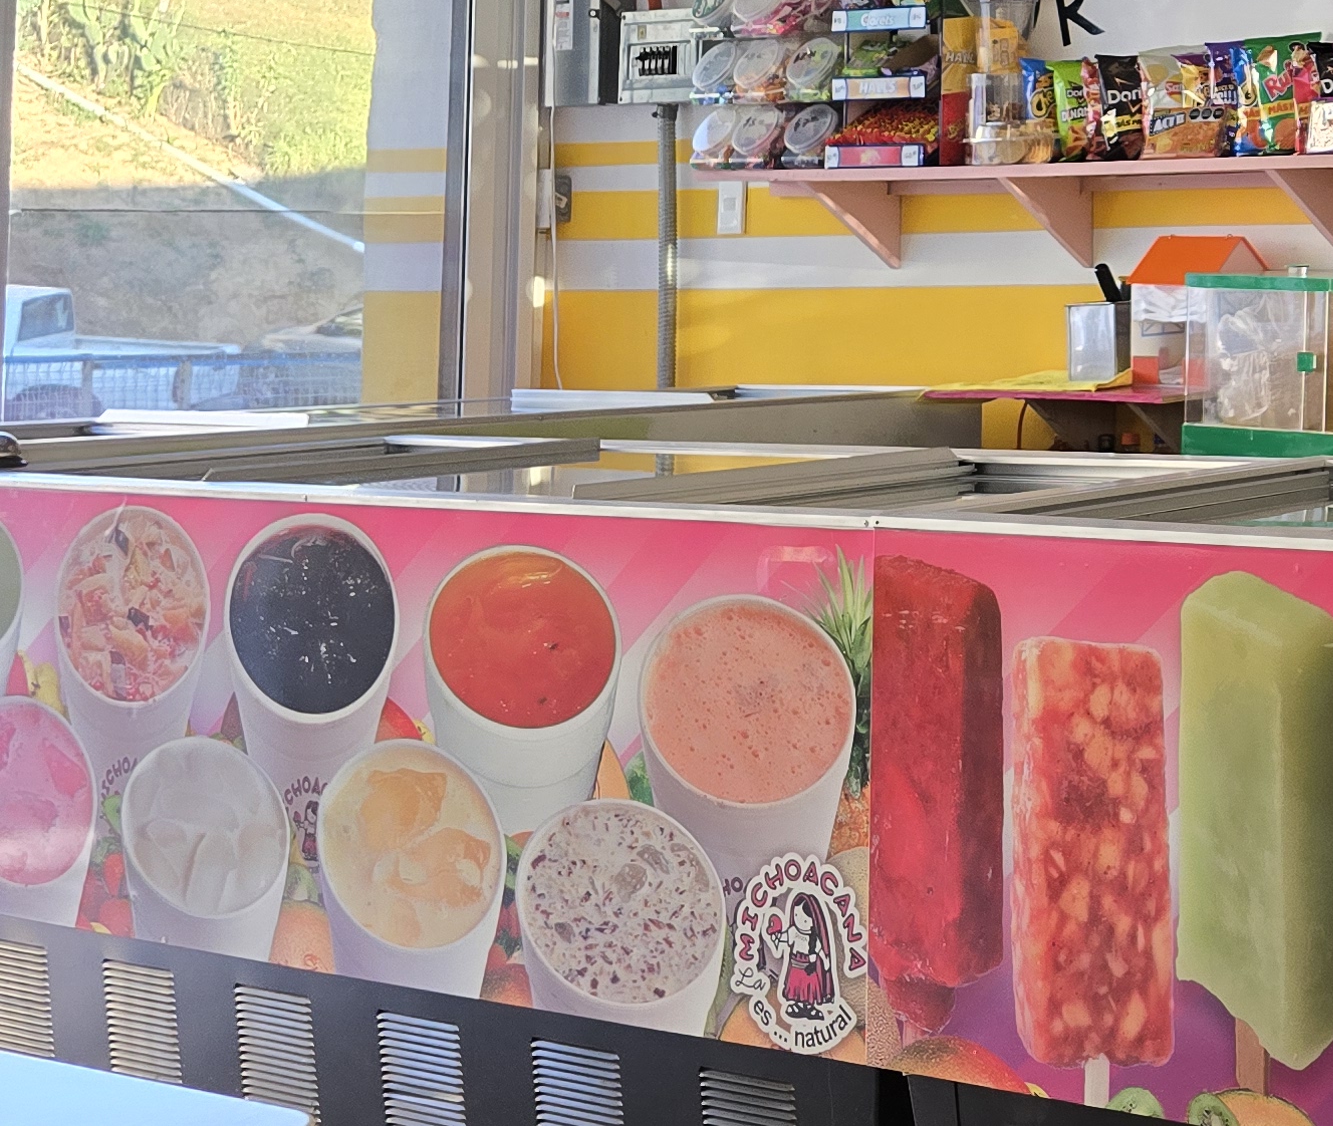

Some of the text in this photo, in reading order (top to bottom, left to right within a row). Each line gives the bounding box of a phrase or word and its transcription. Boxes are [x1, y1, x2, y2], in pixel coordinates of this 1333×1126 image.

[735, 859, 867, 991] La MICHOACANA
[753, 999, 853, 1049] es natural
